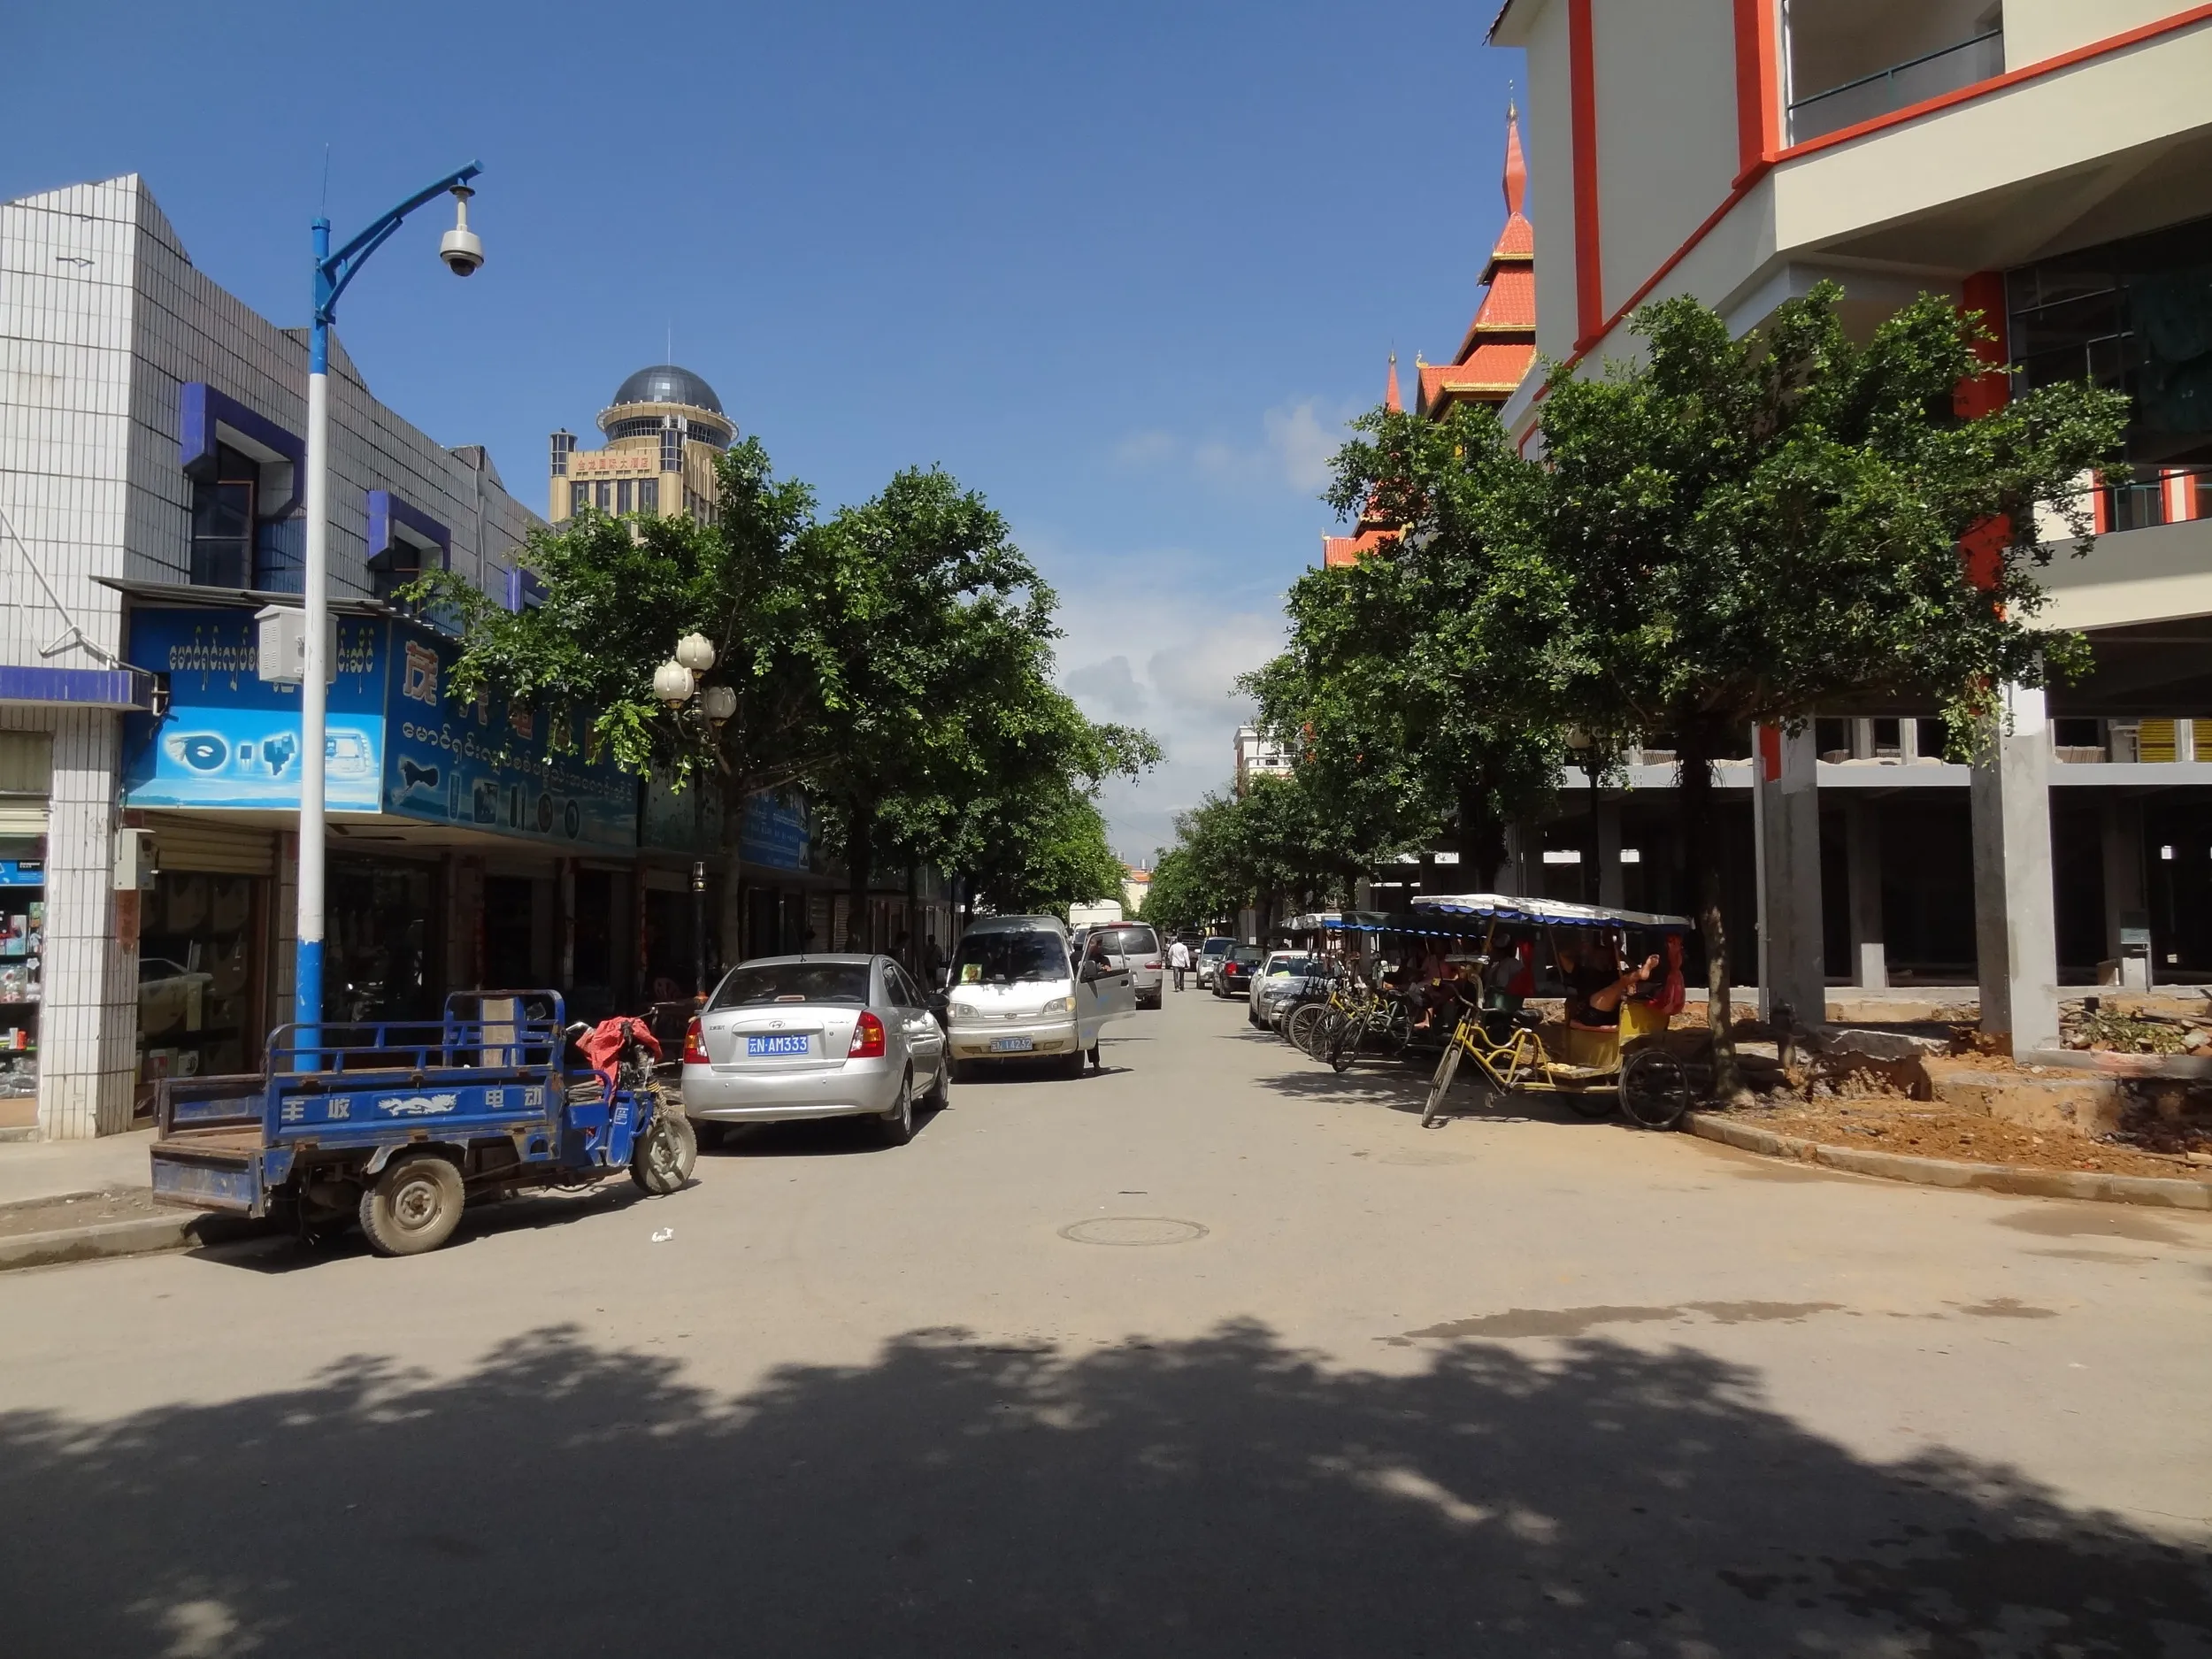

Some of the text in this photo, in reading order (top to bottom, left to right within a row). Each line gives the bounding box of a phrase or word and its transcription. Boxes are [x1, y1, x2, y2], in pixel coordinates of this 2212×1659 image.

[749, 1035, 807, 1053] 云N·AM333
[281, 1087, 543, 1121] 丰收 电动
